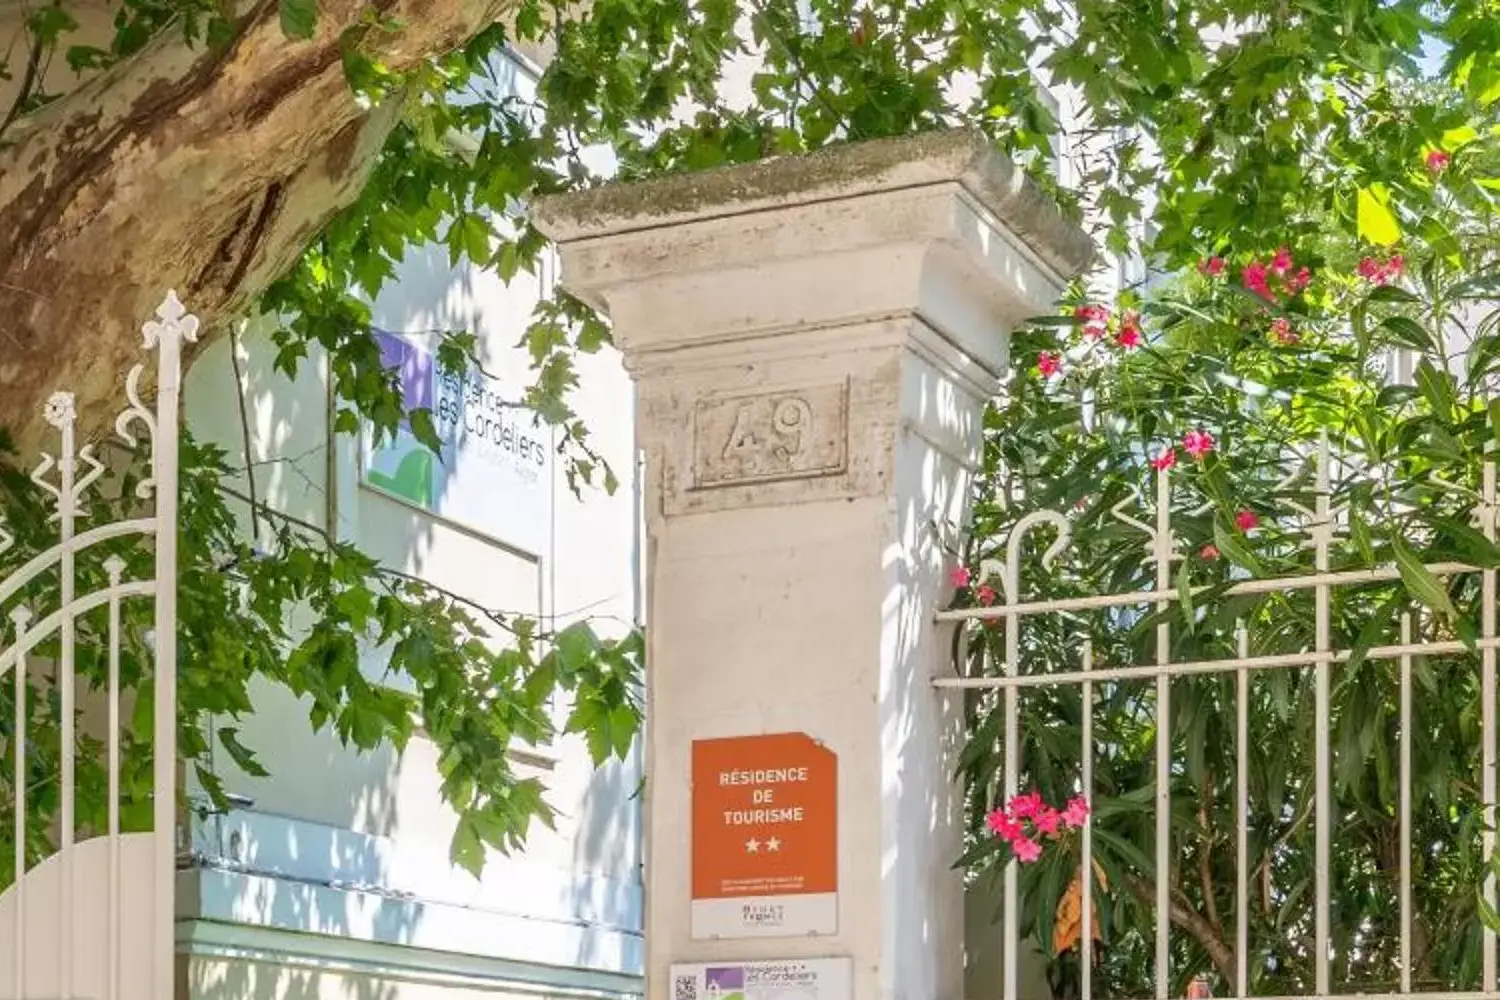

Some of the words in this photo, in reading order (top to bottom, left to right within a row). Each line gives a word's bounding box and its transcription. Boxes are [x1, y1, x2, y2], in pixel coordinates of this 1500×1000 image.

[464, 399, 545, 466] Cordeliers
[719, 768, 809, 786] RÉSIDENCE
[753, 789, 773, 804] DE
[723, 807, 805, 825] TOURISME
